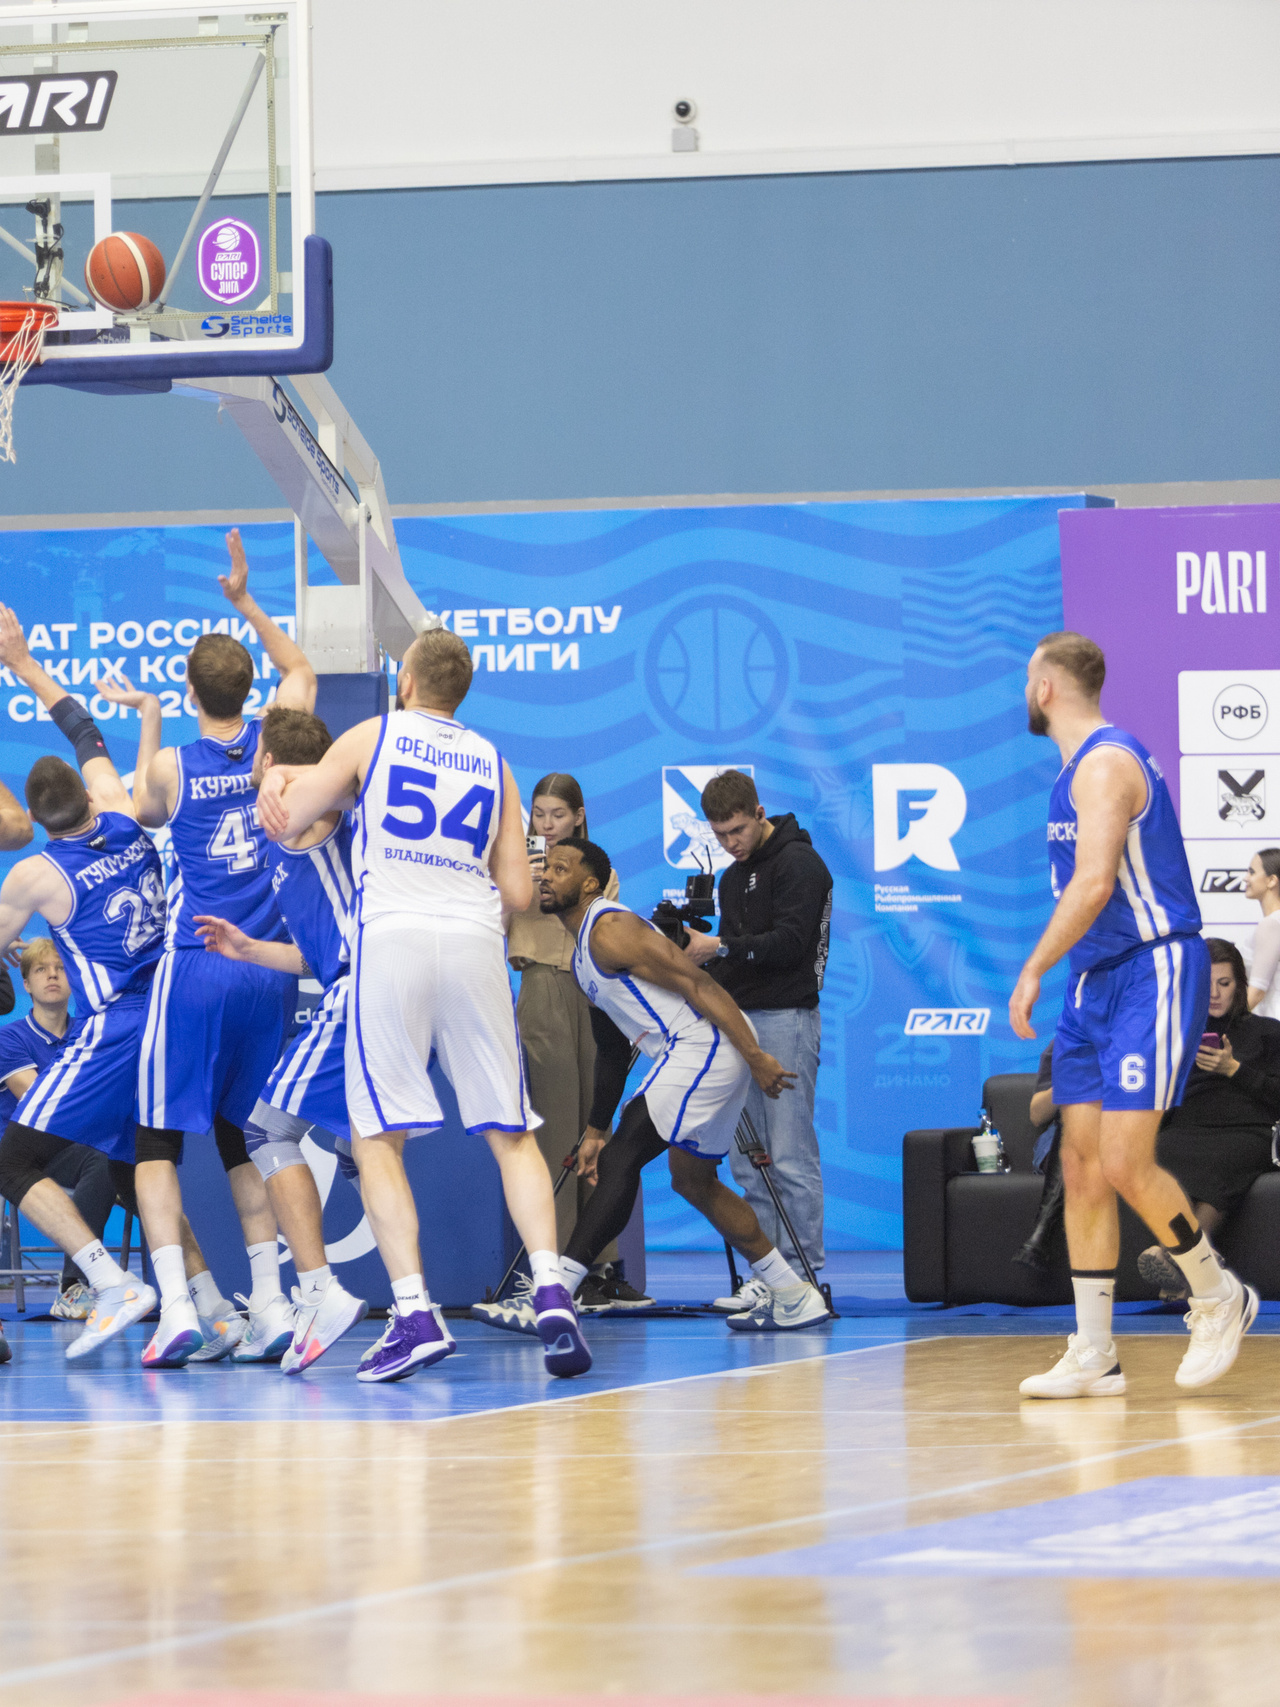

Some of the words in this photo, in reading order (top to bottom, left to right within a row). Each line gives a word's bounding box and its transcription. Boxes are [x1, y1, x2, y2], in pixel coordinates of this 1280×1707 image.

[210, 262, 248, 281] СУПЕР
[218, 281, 239, 294] ЛИГА
[231, 314, 292, 326] Schelde
[231, 323, 292, 337] Sports
[1176, 551, 1267, 614] PARI
[1220, 705, 1261, 719] РФБ
[396, 736, 492, 779] ФЕДЮШИН
[381, 765, 496, 860] 54
[874, 883, 910, 894] Русская
[1202, 870, 1247, 892] PA
[874, 903, 919, 912] Компания
[909, 1013, 986, 1030] PARI
[1119, 1053, 1146, 1092] 6
[89, 1248, 105, 1262] 23
